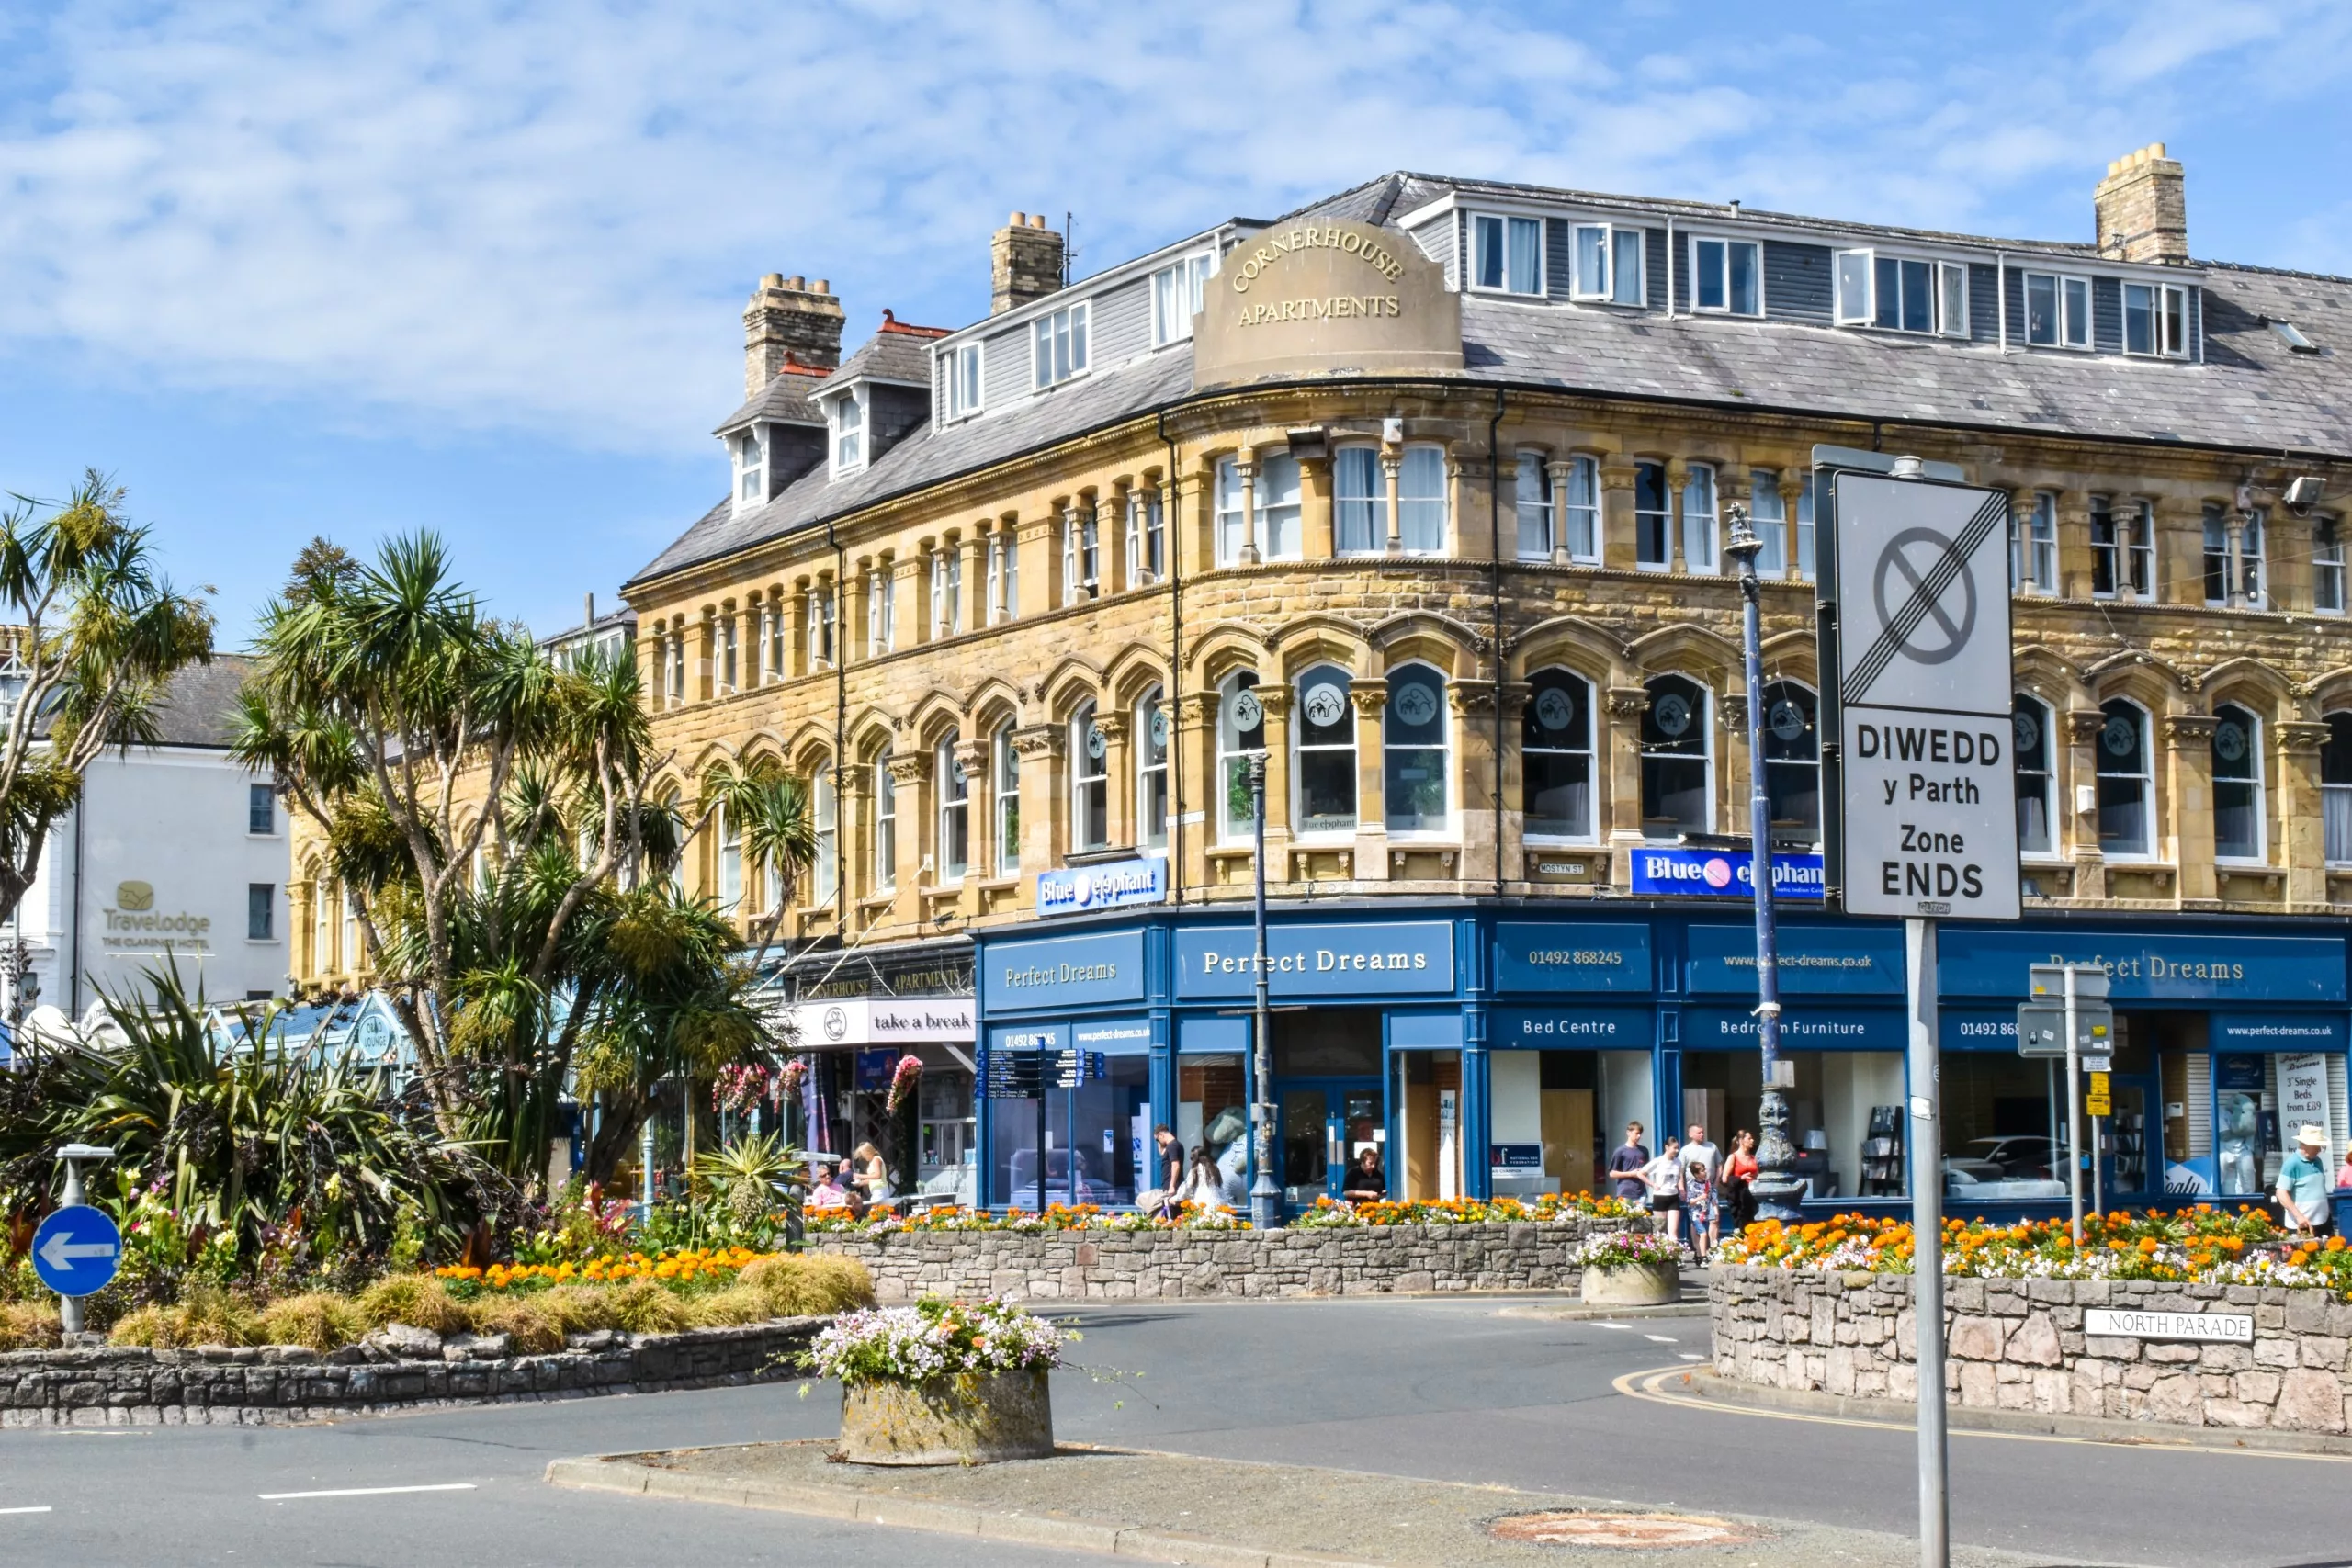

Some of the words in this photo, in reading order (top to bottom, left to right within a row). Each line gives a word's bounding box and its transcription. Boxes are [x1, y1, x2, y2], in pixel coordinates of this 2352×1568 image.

[1233, 228, 1404, 293] CORNERHOUSE
[1239, 295, 1400, 327] APARTMENTS
[1858, 724, 2000, 766] DIWEDD
[1883, 779, 1897, 805] y
[1909, 773, 1980, 805] Parth
[1900, 825, 1964, 854] Zone
[1541, 864, 1571, 873] MOSTYN
[1645, 856, 1702, 880] Blue
[1882, 862, 1983, 899] ENDS
[1042, 880, 1075, 905] Blue
[1918, 903, 1950, 913] GLITCH
[102, 908, 210, 937] Travelodge
[102, 937, 122, 947] THE
[1316, 950, 1427, 972] Dreams
[1529, 952, 1569, 964] 01492
[1573, 951, 1622, 964] 868245
[1005, 969, 1055, 987] Perfect
[1059, 962, 1117, 983] Dreams
[2050, 955, 2141, 977] Pfect
[2150, 956, 2243, 979] Dreams
[875, 1013, 910, 1031] take
[912, 1017, 922, 1029] a
[925, 1012, 971, 1031] break
[1523, 1021, 1554, 1034] Bed
[1560, 1021, 1616, 1034] Centre
[1721, 1021, 1788, 1034] Bedrm
[1792, 1021, 1865, 1034] Furniture
[1960, 1023, 1997, 1036] 01492
[1078, 1026, 1150, 1043] www.perfect-dreams.co.uk
[2227, 1025, 2332, 1037] www.perfect-dreams.co.uk
[1005, 1034, 1027, 1048] 01492
[2287, 1060, 2320, 1071] Dreams
[2294, 1076, 2317, 1088] Single
[2294, 1089, 2312, 1100] Beds
[2287, 1102, 2304, 1111] from
[2306, 1101, 2322, 1111] £89
[2109, 1314, 2168, 1333] NORTH
[2176, 1316, 2247, 1337] PARADE
